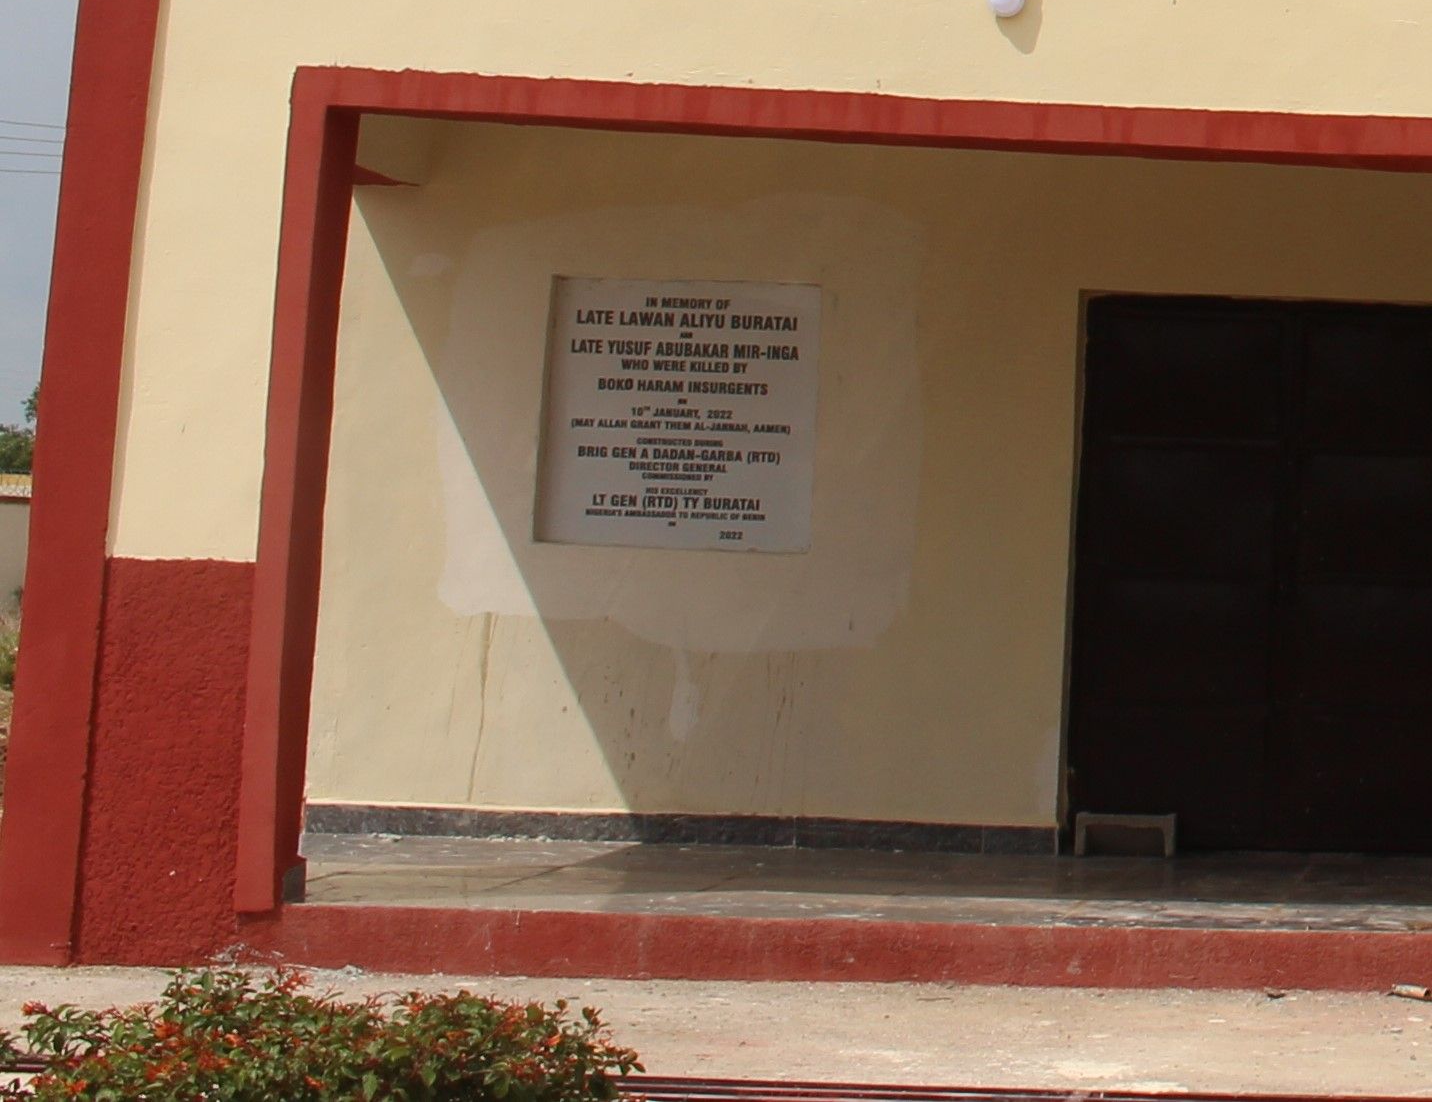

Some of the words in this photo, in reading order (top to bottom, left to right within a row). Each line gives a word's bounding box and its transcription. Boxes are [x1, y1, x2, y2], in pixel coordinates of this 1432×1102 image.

[646, 297, 657, 308] IN
[661, 298, 712, 309] MEMORY
[716, 299, 731, 309] OF
[576, 310, 613, 325] LATE
[620, 312, 674, 327] LAWAN
[680, 314, 726, 328] ALIYU
[731, 315, 798, 331] BURATAI
[571, 339, 603, 354] LATE
[607, 341, 652, 356] YUSUF
[656, 343, 729, 358] ABUBAKAR
[733, 345, 799, 360] MIR-INGA
[621, 359, 649, 370] WHO
[653, 360, 686, 372] WERE
[690, 362, 729, 373] KILLED
[733, 362, 747, 374] BY
[598, 378, 634, 391] BOKO
[637, 380, 684, 393] HARAM
[688, 381, 768, 395] INSURGENTS
[653, 408, 701, 419] JANUARY,
[707, 410, 733, 419] 2022
[571, 418, 594, 428] (MAY
[597, 419, 627, 428] ALLAH
[630, 420, 661, 430] GRANT
[665, 421, 691, 431] THEM
[637, 437, 692, 447] CONSTRUCTED
[578, 446, 607, 458] BRIG
[612, 447, 636, 459] GEN
[640, 448, 649, 459] A
[652, 448, 743, 462] DADAN-GARBA
[747, 451, 781, 465] (RTD)
[629, 461, 679, 472] DIRECTOR
[682, 463, 727, 473] GENERAL
[661, 488, 708, 496] EXCELLENCY
[593, 495, 606, 506] LT
[610, 495, 636, 507] GEN
[642, 496, 678, 510] (RTD)
[684, 497, 698, 509] TY
[703, 498, 761, 511] BURATAI
